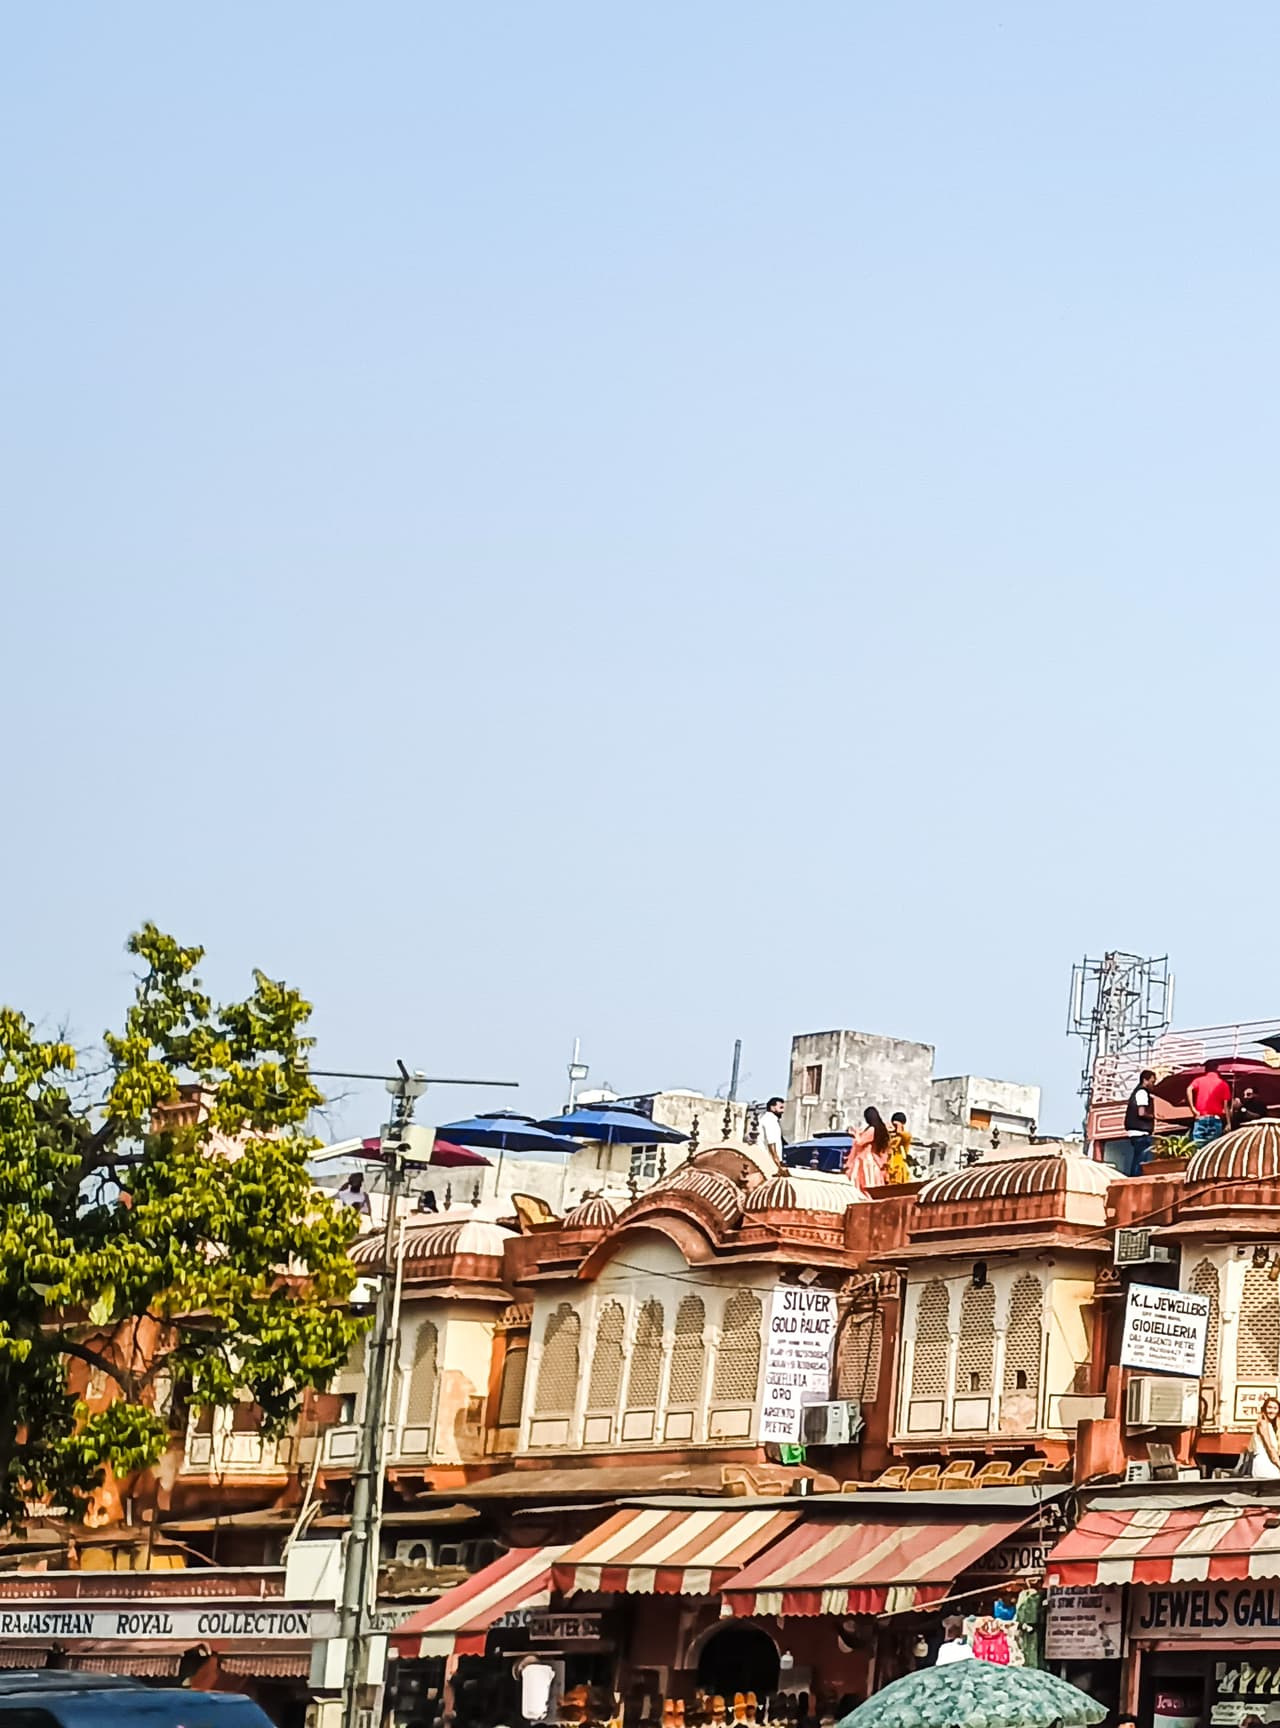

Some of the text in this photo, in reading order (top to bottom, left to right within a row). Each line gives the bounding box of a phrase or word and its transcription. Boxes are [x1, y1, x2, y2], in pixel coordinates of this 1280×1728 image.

[783, 1291, 831, 1312] SILVER
[1154, 1297, 1208, 1317] JEWELLERS
[772, 1316, 831, 1334] GOLD PALACE
[1131, 1318, 1197, 1340] GIOIELLERIA
[772, 1388, 792, 1401] ORO
[1139, 1589, 1231, 1629] JEWELS
[1, 1612, 312, 1635] RAJASTHAN ROYAL COLLECTION
